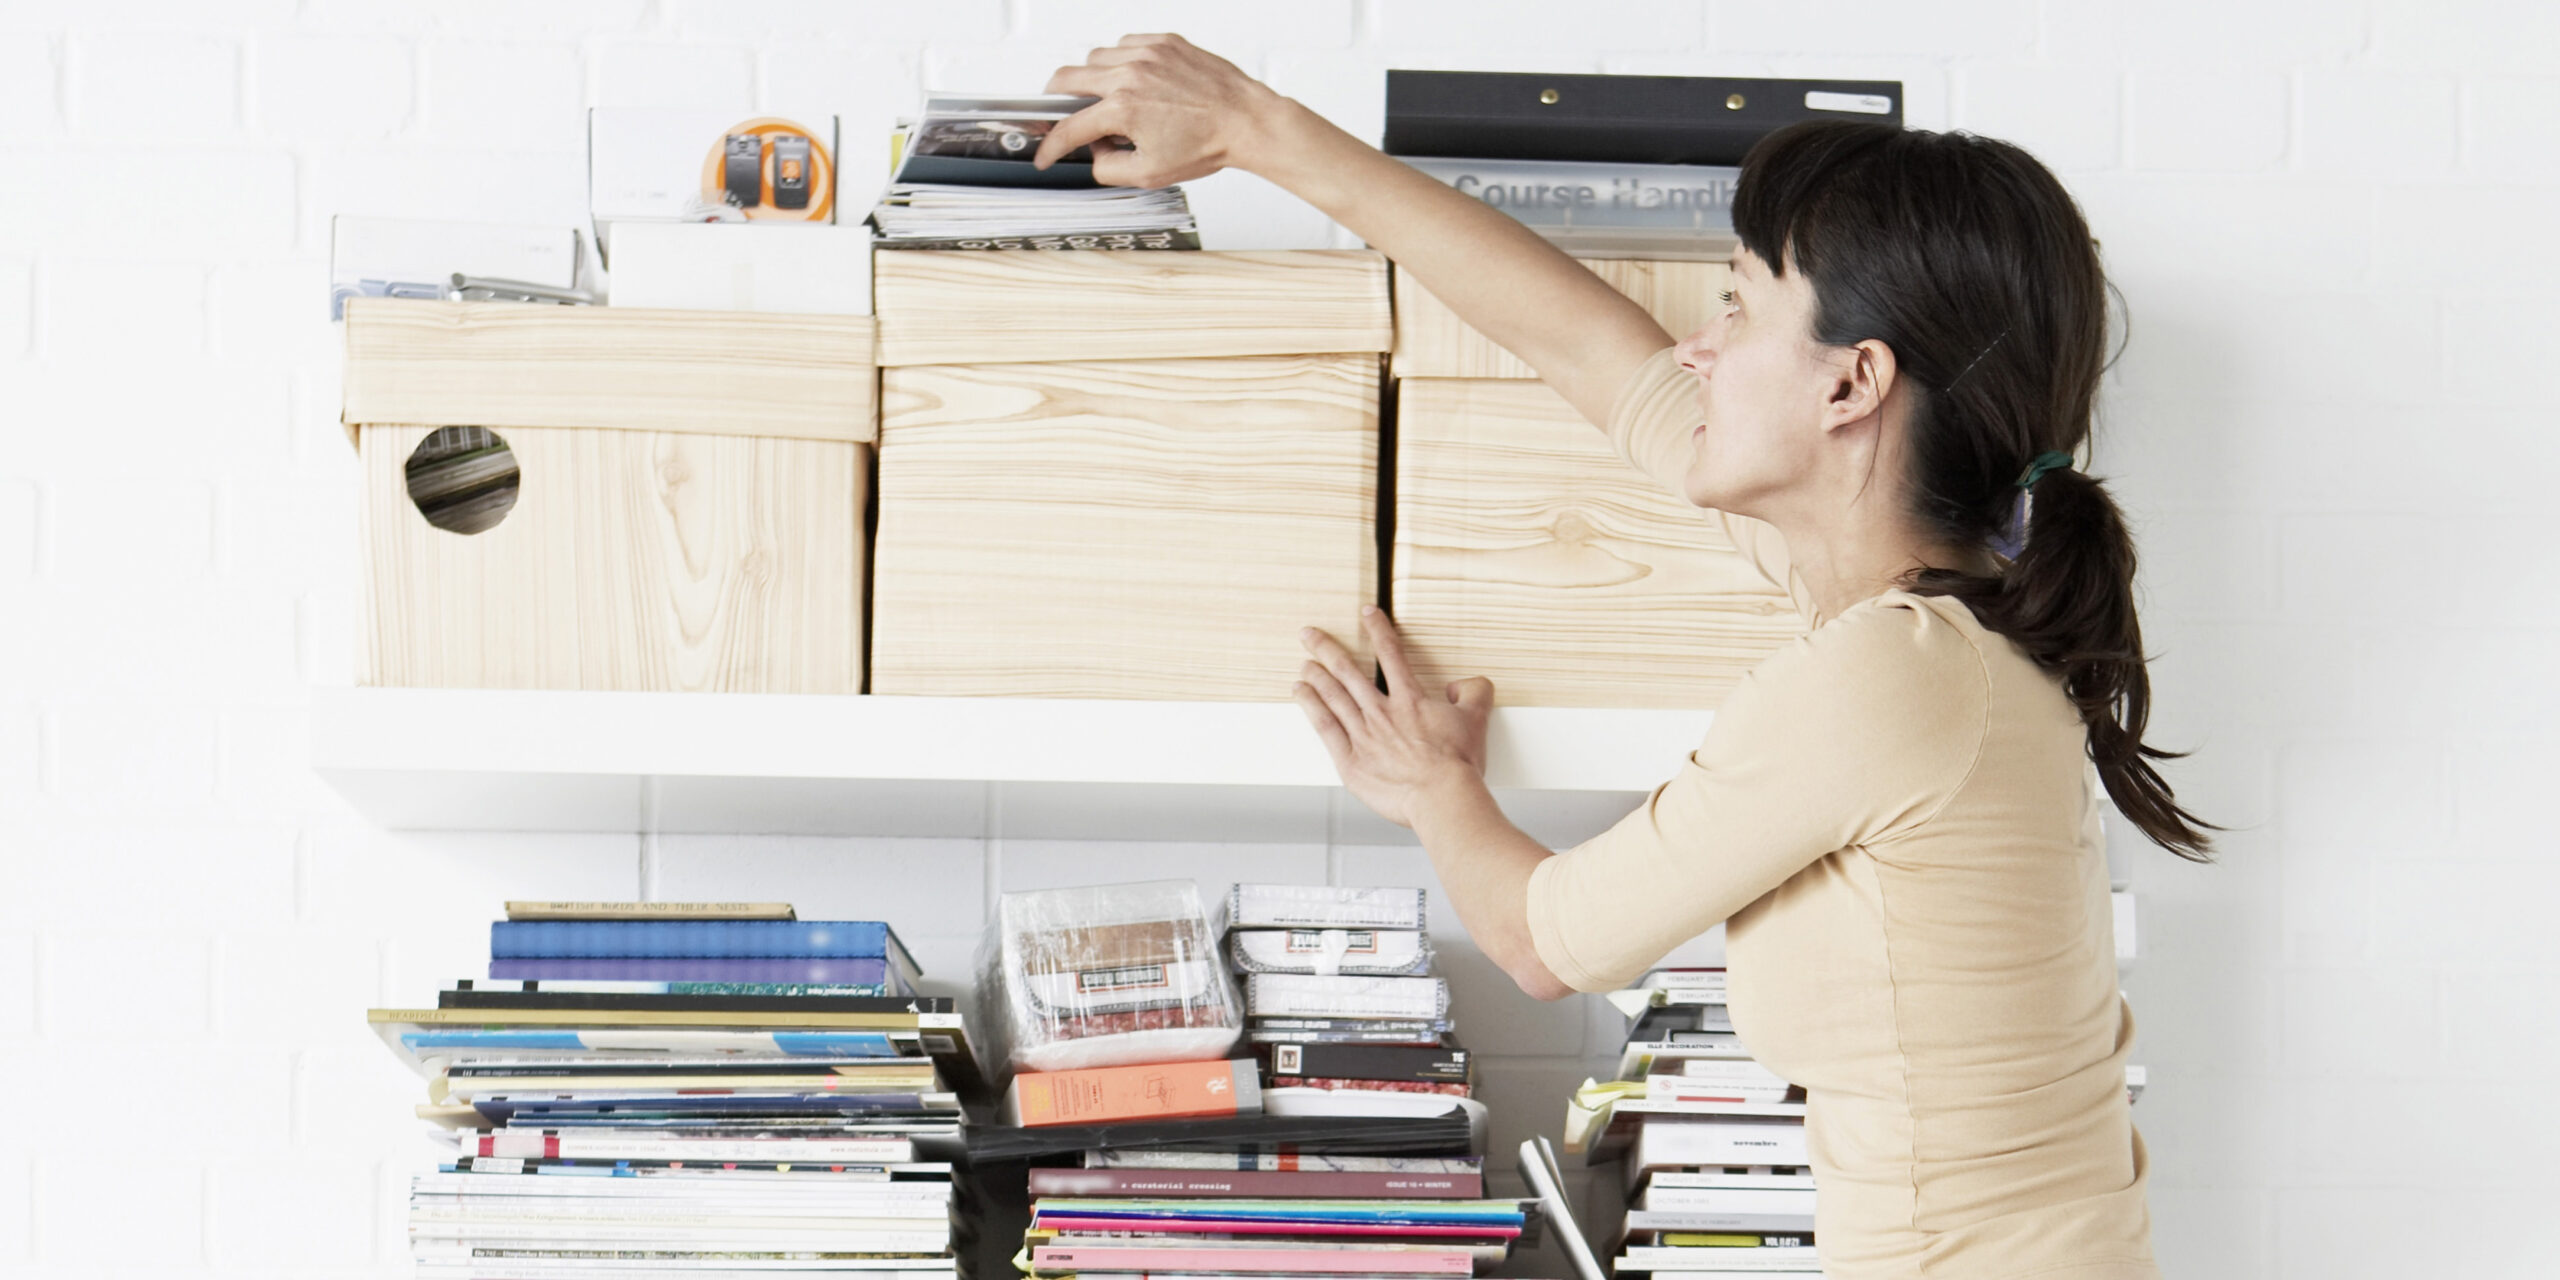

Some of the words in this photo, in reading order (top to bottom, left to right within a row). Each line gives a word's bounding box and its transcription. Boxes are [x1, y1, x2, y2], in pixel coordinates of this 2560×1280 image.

[1454, 174, 1597, 209] Course
[602, 903, 635, 912] BIRDS
[642, 903, 668, 912] AND
[675, 903, 709, 912] THEIR
[717, 903, 751, 912] NESTS
[389, 1010, 448, 1021] BEARDSLEY
